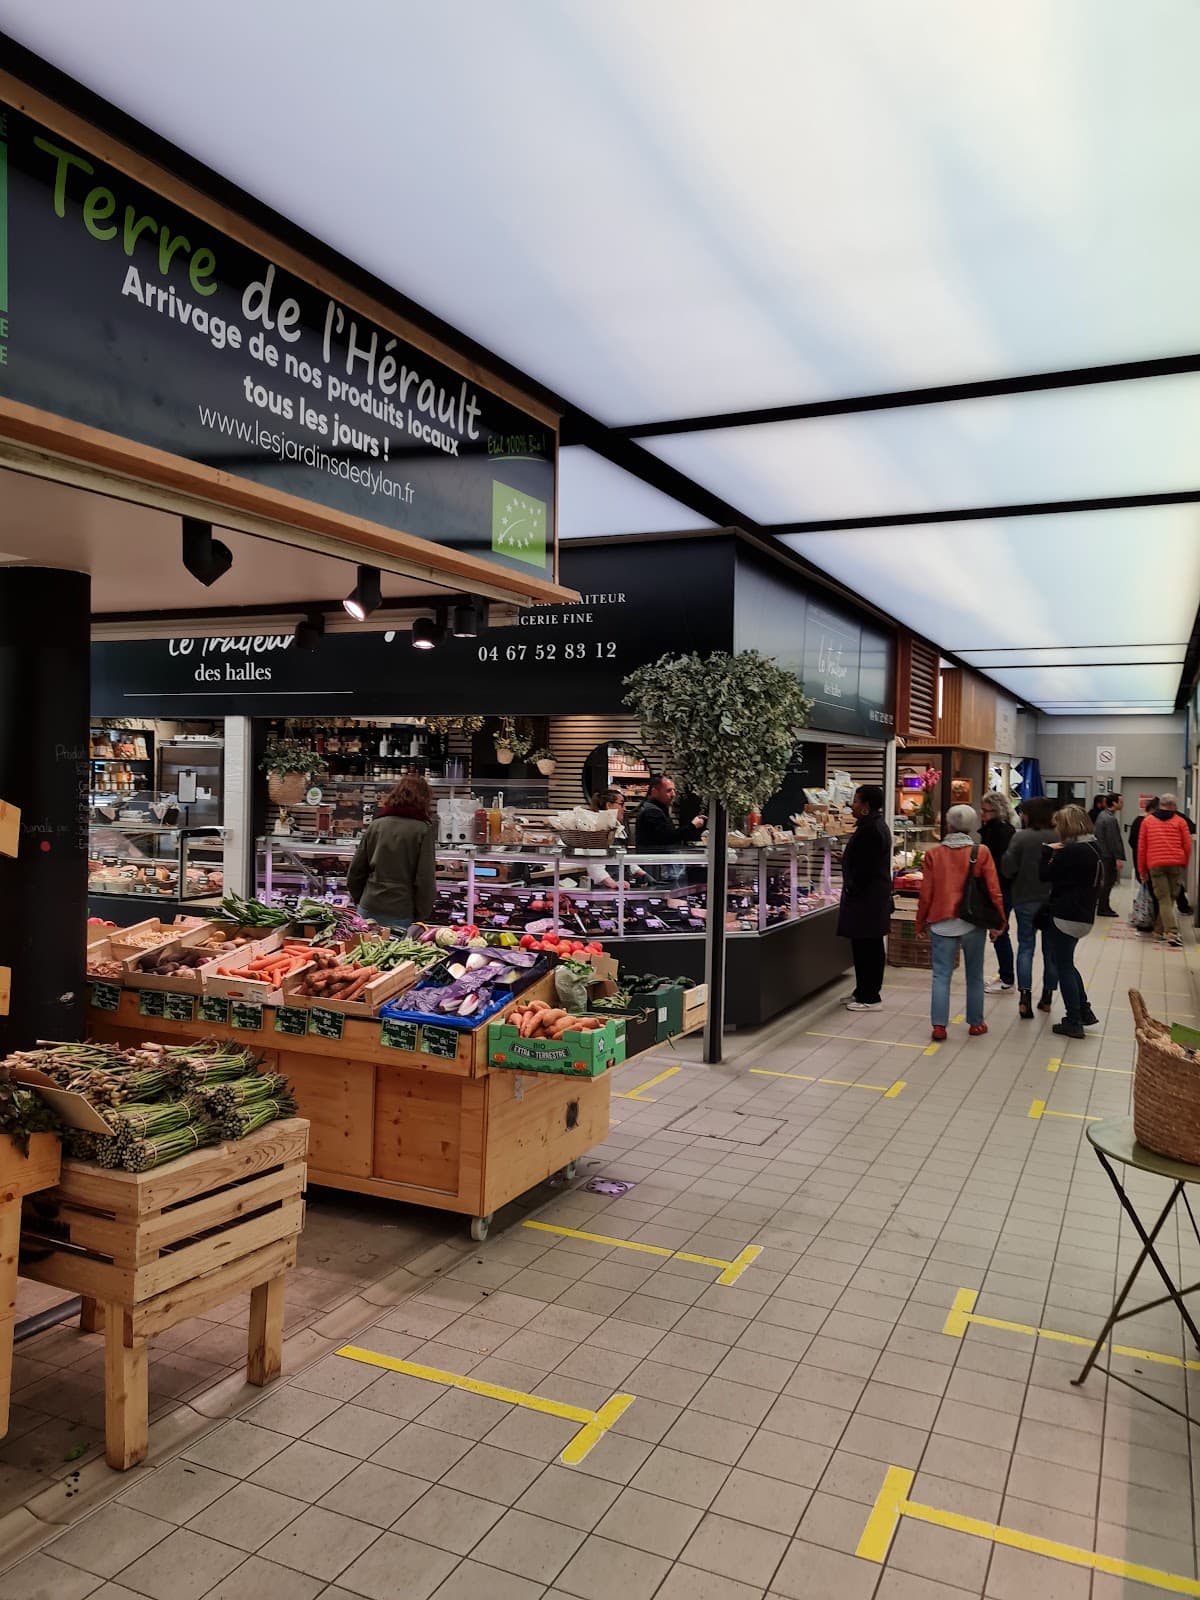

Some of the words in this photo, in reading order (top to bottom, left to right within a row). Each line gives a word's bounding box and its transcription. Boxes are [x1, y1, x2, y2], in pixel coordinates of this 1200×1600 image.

[33, 135, 218, 296] Terre
[241, 264, 301, 343] de
[323, 300, 482, 440] l'Hérault
[121, 264, 242, 349] Arrivage
[249, 333, 279, 367] de
[285, 353, 322, 388] nos
[328, 375, 404, 430] produits
[407, 408, 459, 457] locaux
[244, 375, 293, 420] tous
[300, 396, 328, 435] les
[199, 404, 415, 505] www.lesjardinsdedylan.fr
[561, 592, 627, 606] AITEUR
[563, 612, 593, 624] FINE
[478, 645, 499, 662] 04
[506, 644, 528, 661] 67
[535, 643, 556, 660] 52
[565, 642, 586, 659] 83
[596, 641, 617, 658] 12
[194, 663, 221, 682] des
[225, 662, 272, 681] halles
